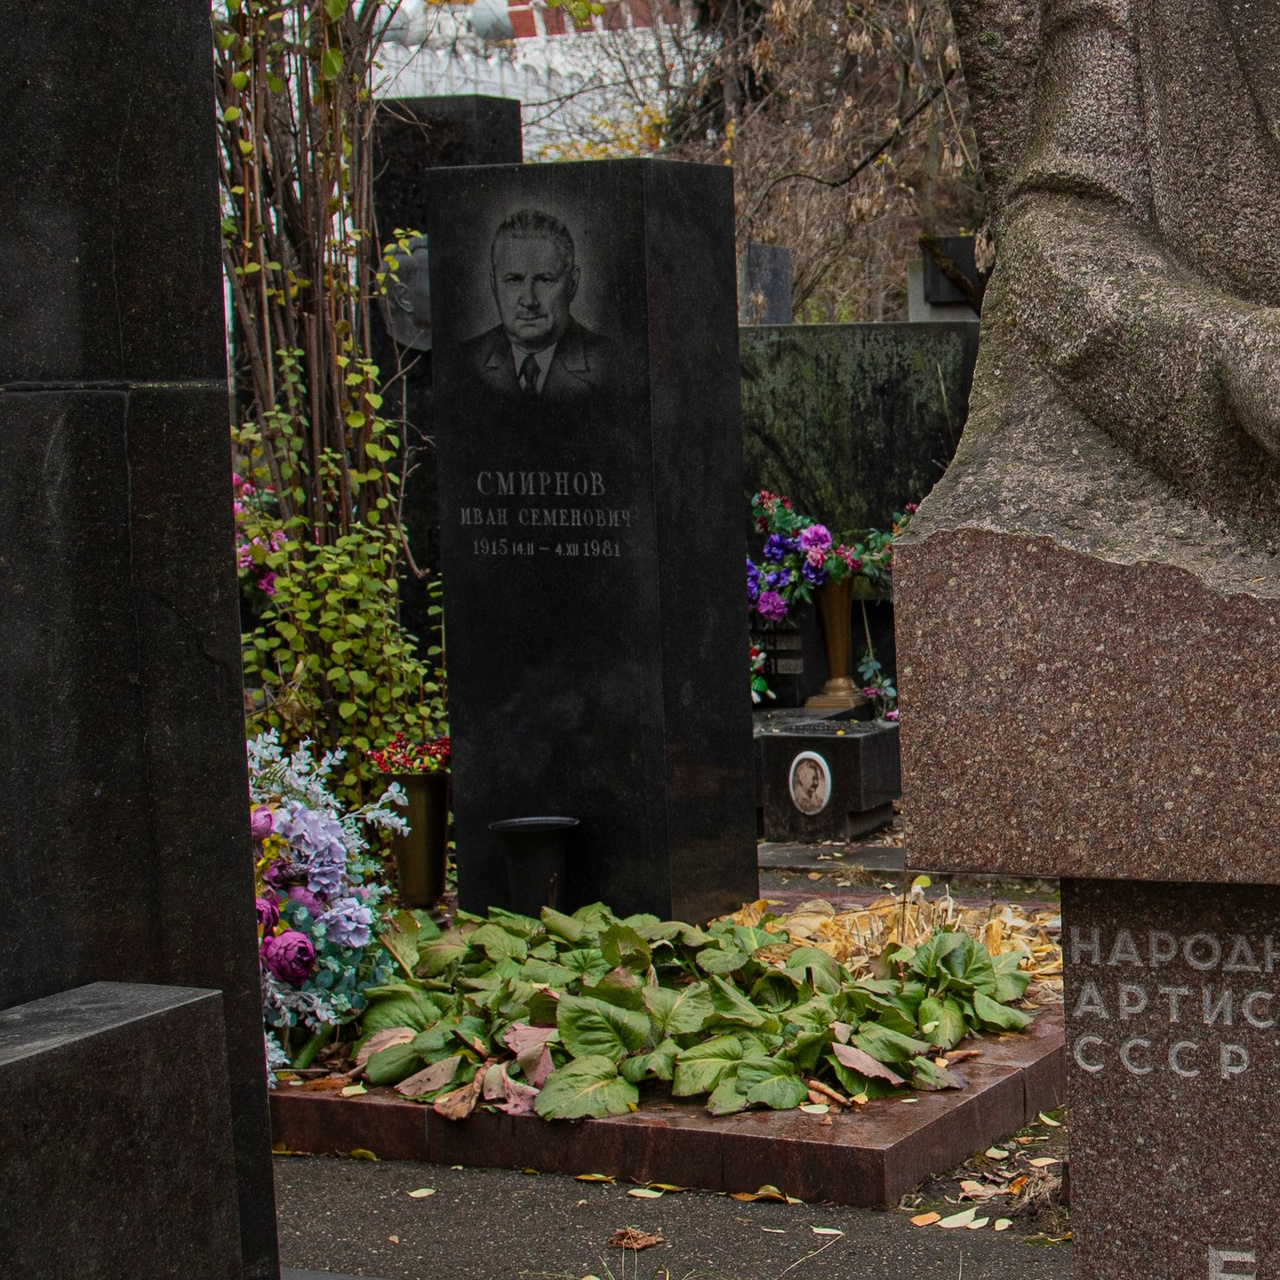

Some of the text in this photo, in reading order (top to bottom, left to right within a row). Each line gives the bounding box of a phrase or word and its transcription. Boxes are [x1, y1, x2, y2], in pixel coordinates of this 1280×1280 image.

[477, 471, 606, 496] СМИРНОВ
[460, 507, 632, 527] ИВАН СЕМЕНОВИЧ
[473, 538, 508, 556] 1915
[583, 539, 621, 557] 1981
[1072, 1035, 1250, 1080] СССР
